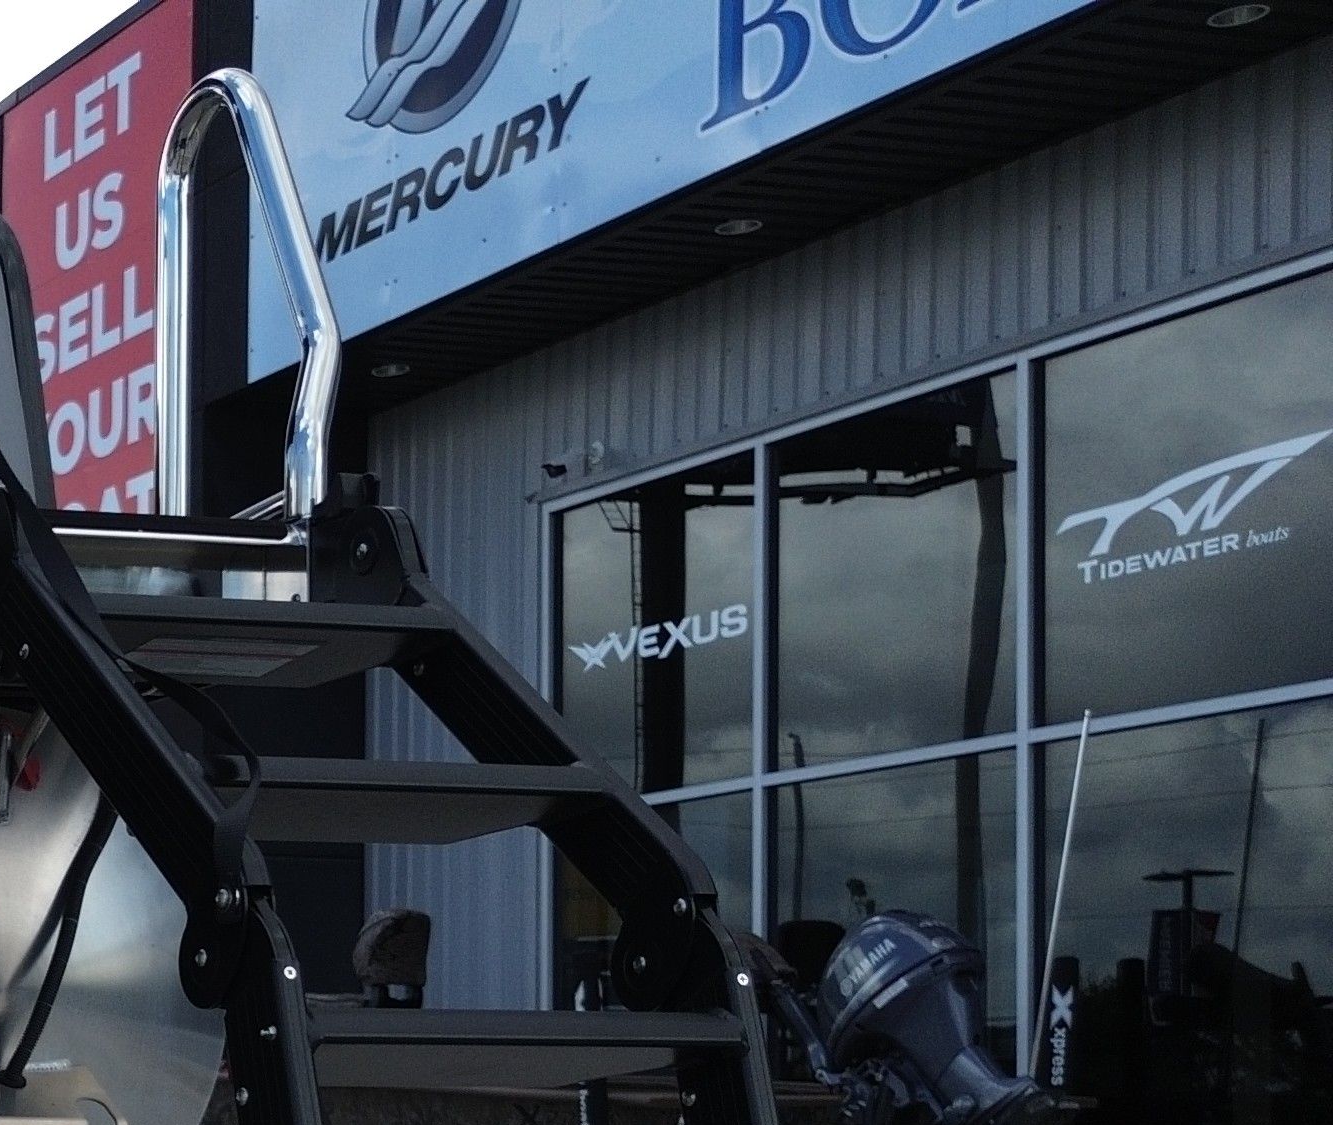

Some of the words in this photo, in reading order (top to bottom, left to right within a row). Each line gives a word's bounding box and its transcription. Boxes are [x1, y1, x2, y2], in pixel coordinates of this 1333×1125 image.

[43, 51, 142, 182] LET
[316, 76, 591, 263] MERCURY
[55, 172, 124, 270] US
[34, 264, 154, 385] SELL
[44, 363, 155, 476] OUR
[610, 604, 749, 662] VEXUS
[848, 938, 897, 985] YAMAHA
